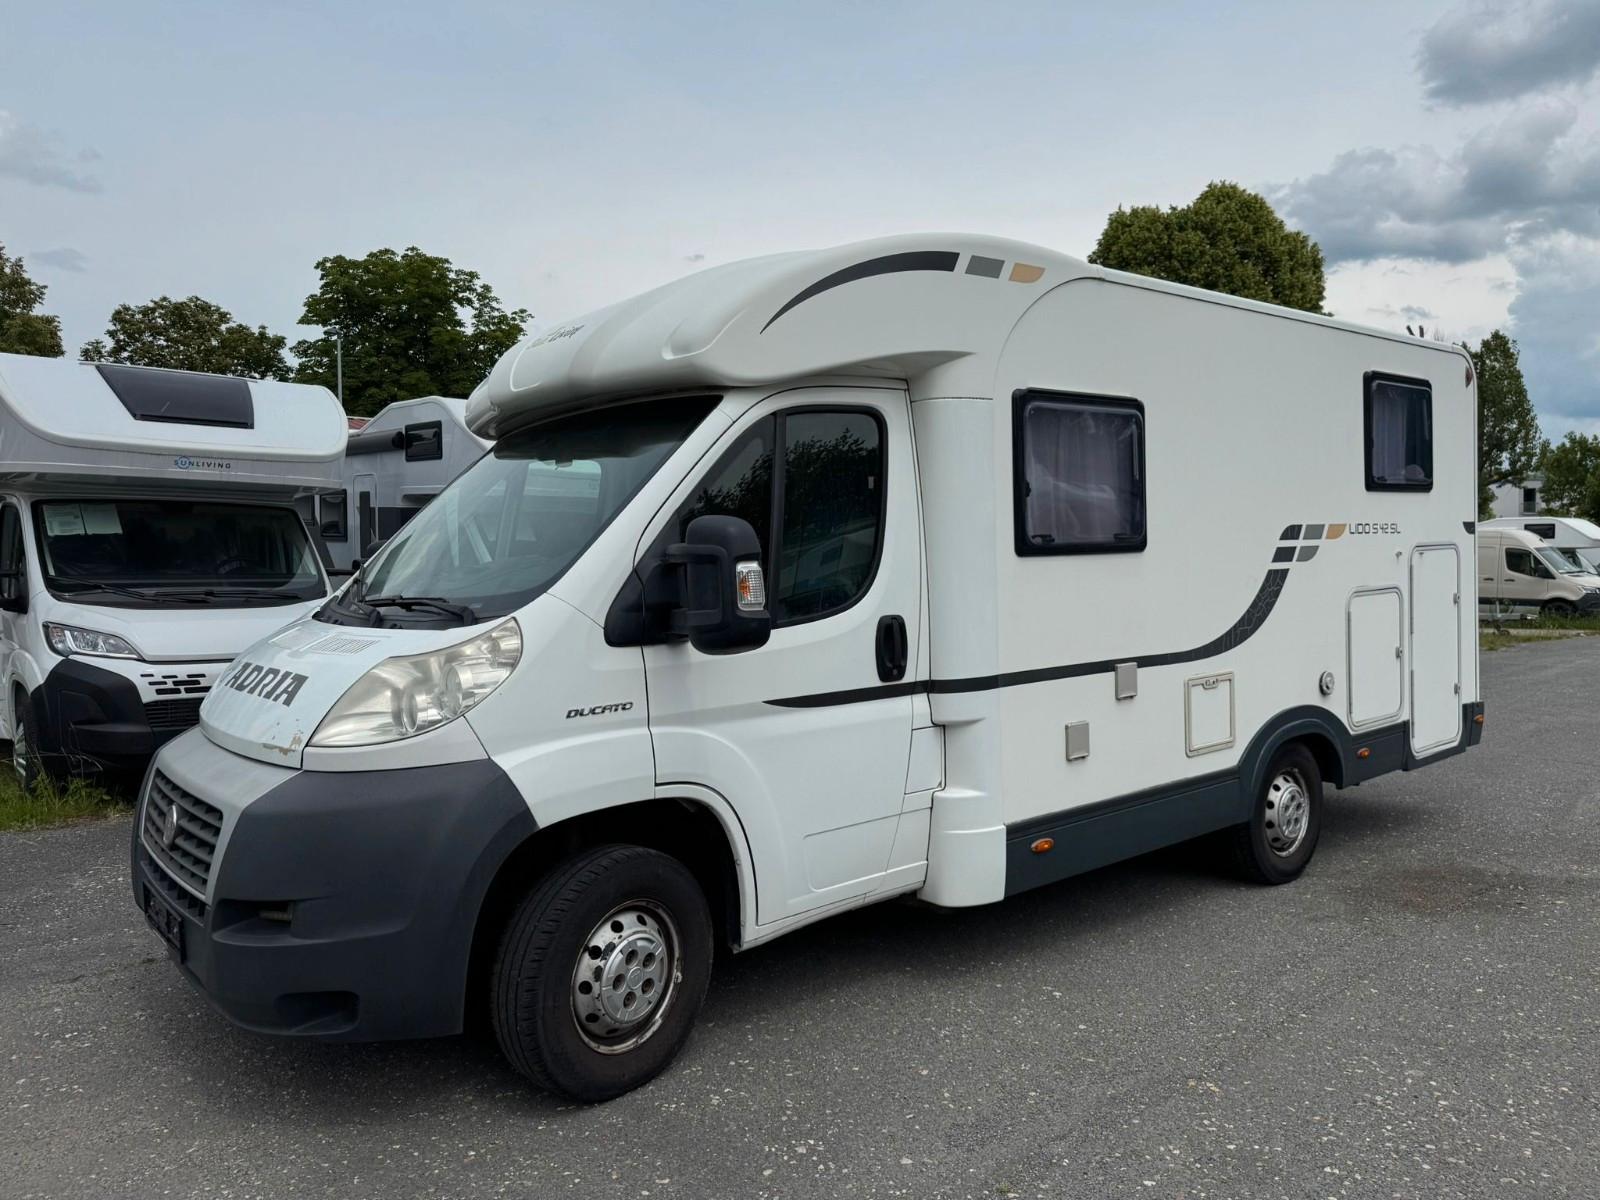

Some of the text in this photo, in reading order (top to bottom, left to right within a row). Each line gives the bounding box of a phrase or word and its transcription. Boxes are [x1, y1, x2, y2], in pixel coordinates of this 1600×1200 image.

[174, 458, 231, 469] SUNLIVING
[1349, 523, 1370, 534] LIDO
[224, 662, 309, 707] ADRIA
[566, 702, 633, 719] DUCATO
